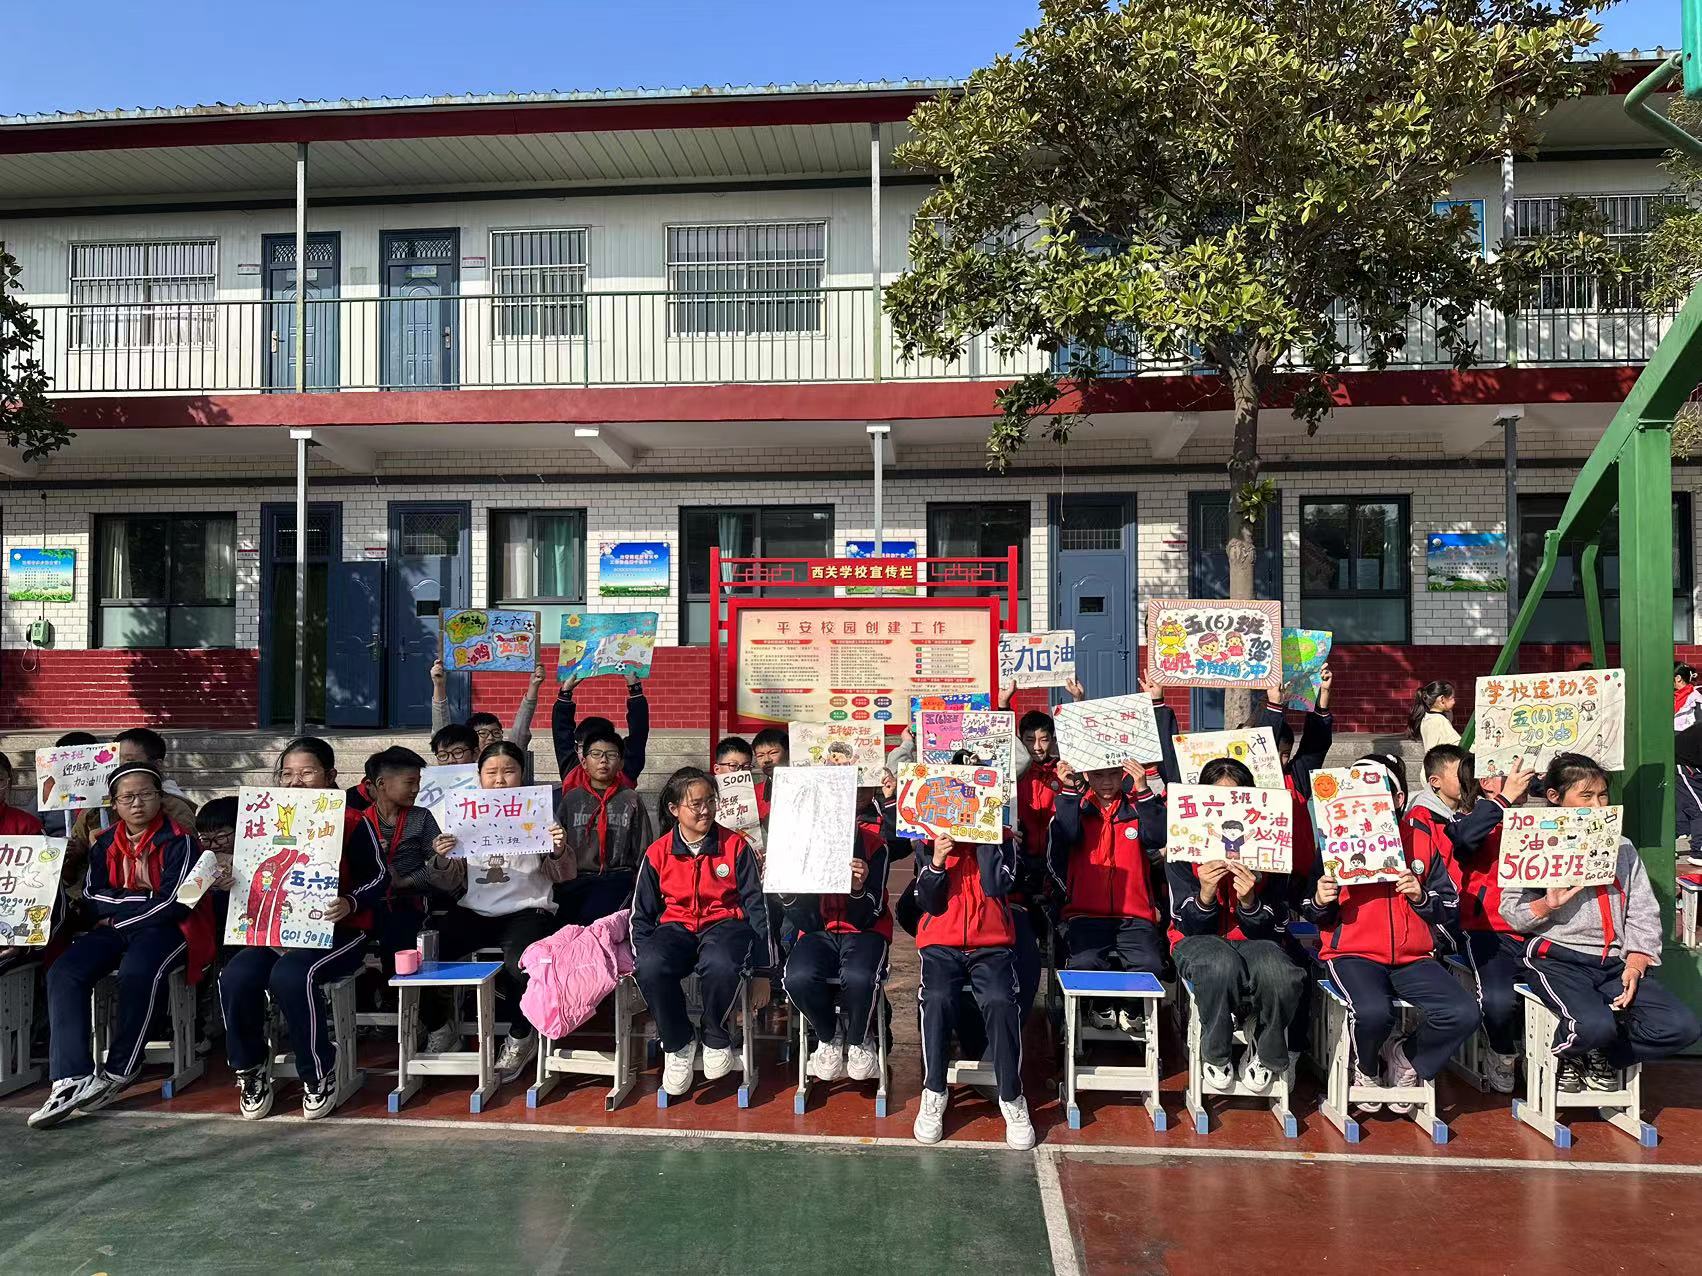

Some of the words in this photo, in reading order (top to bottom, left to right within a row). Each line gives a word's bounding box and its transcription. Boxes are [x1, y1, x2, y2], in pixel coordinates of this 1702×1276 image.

[811, 565, 914, 579] 西关学校宣传栏
[776, 621, 947, 635] 平安校园创建工作
[1184, 614, 1266, 637] 五(6)班
[1013, 636, 1075, 673] 加油
[1484, 675, 1599, 705] 学校运动会
[1082, 710, 1138, 729] 五六班
[1510, 707, 1575, 729] 五(6)班
[1519, 722, 1573, 743] 加油
[480, 835, 521, 847] 五六班
[1499, 852, 1585, 881] 5(6)班
